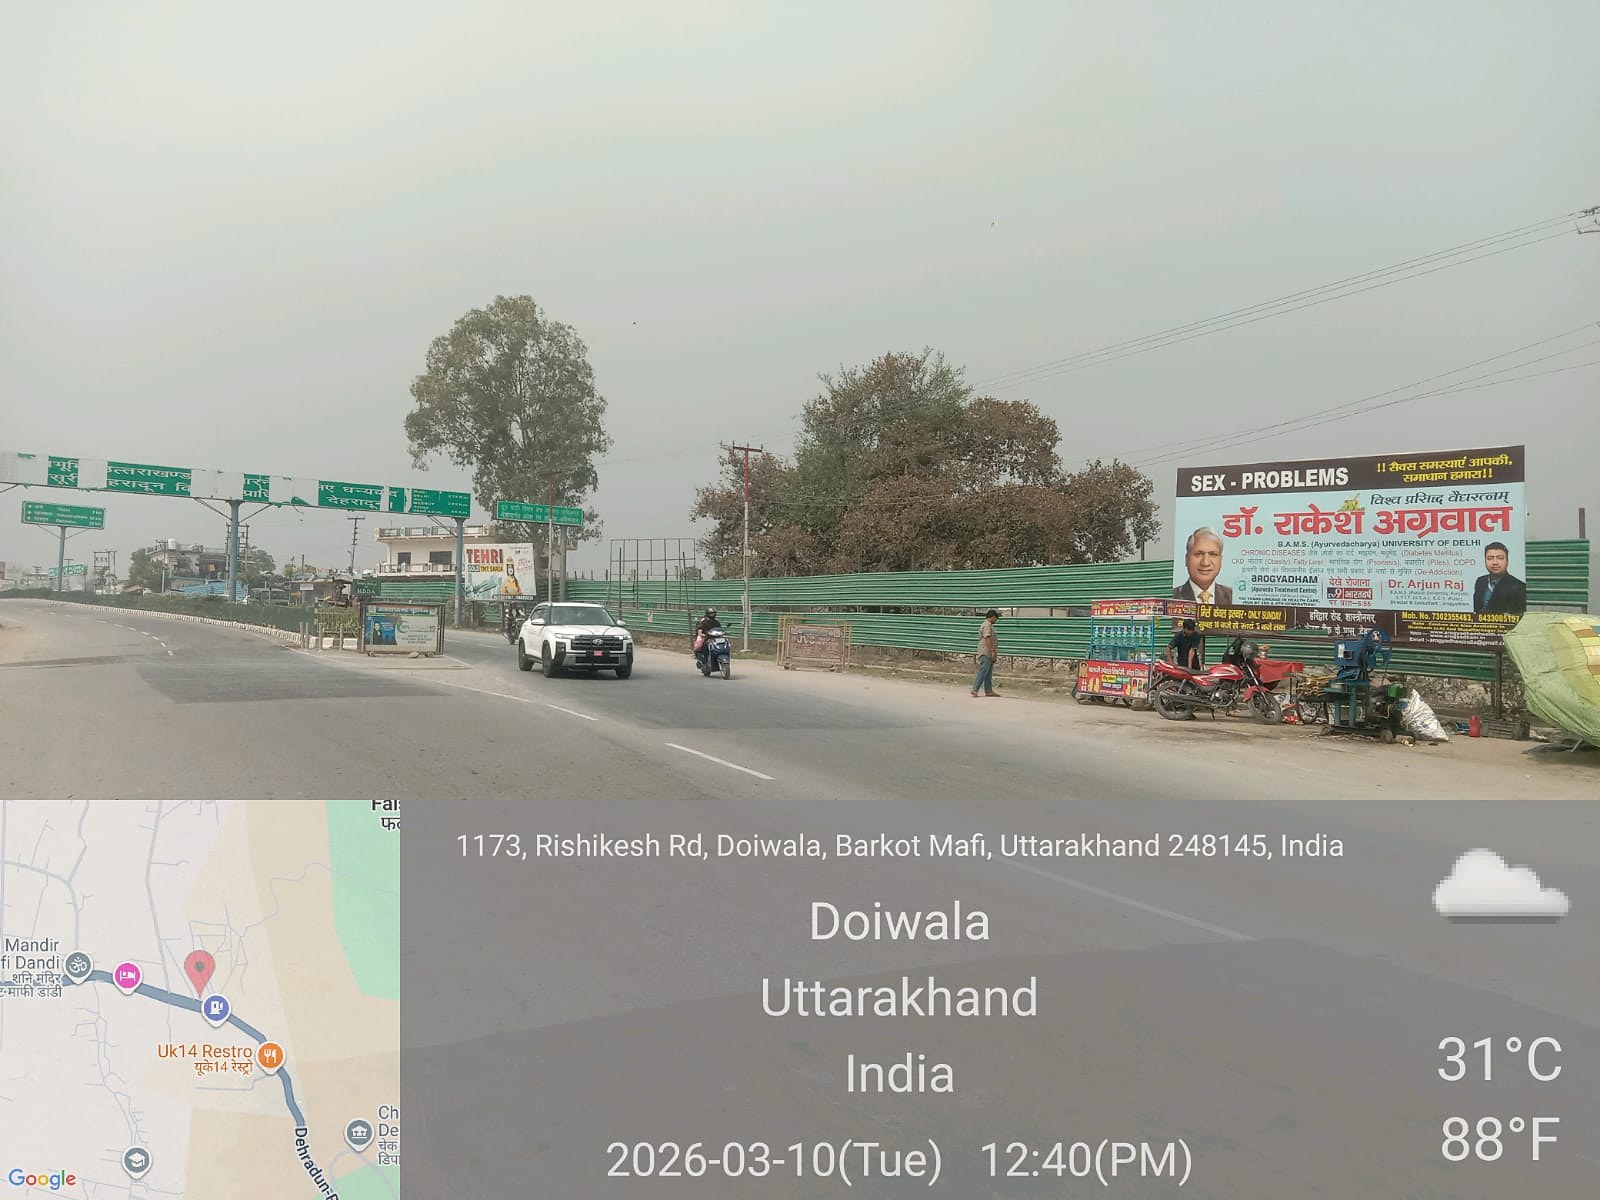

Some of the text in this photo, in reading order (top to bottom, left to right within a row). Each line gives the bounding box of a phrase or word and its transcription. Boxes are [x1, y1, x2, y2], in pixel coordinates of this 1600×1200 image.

[107, 478, 165, 492] हरादून
[1191, 474, 1226, 492] SEX
[1242, 467, 1349, 489] PROBLEMS
[1223, 504, 1513, 539] डॉ. राकेश अग्रवाल
[1311, 540, 1379, 549] (Ayurvedacharya)
[1382, 539, 1435, 547] UNIVERSITY
[1437, 539, 1450, 547] OF
[1453, 539, 1481, 547] DELHI
[466, 548, 503, 563] TEHRI
[1388, 579, 1464, 591] Dr. Arjun Raj
[1402, 611, 1418, 619] Mob.
